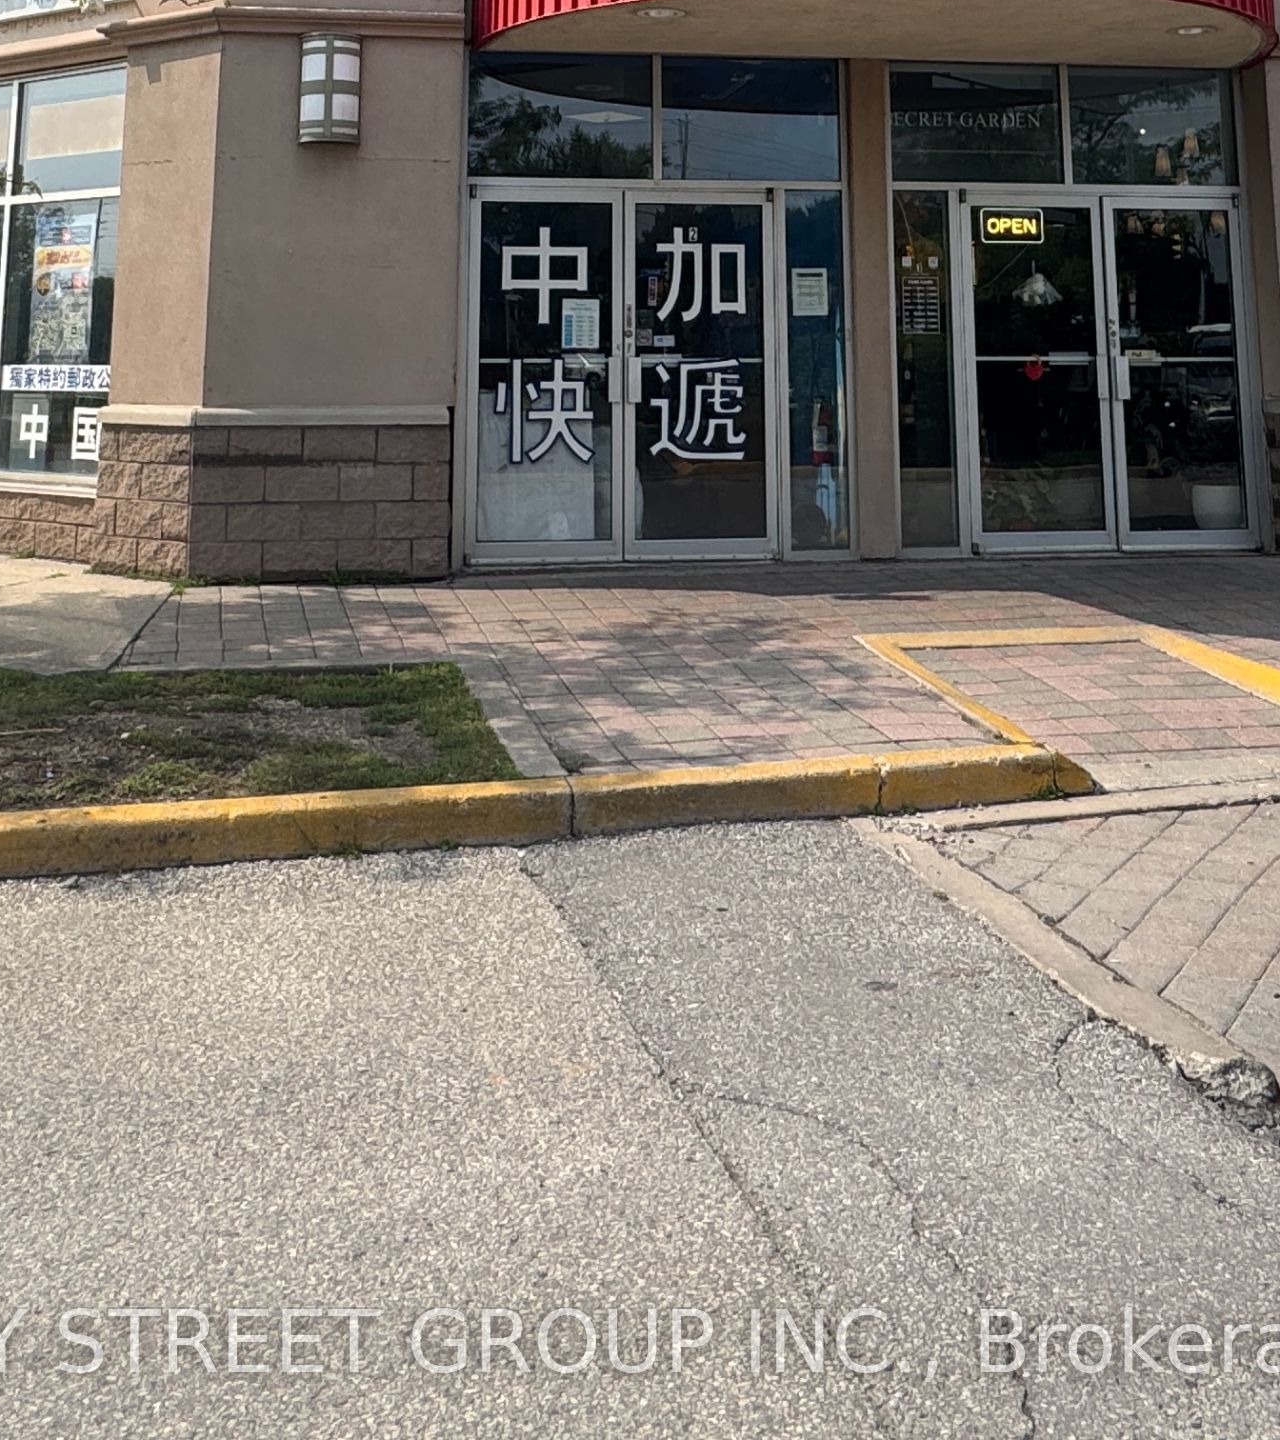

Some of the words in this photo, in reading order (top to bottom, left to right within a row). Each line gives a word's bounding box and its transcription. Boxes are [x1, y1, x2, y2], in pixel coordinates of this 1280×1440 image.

[959, 111, 1042, 130] GARDEN
[986, 217, 1038, 236] OPEN
[502, 227, 746, 324] 中加
[495, 360, 746, 462] 快遞
